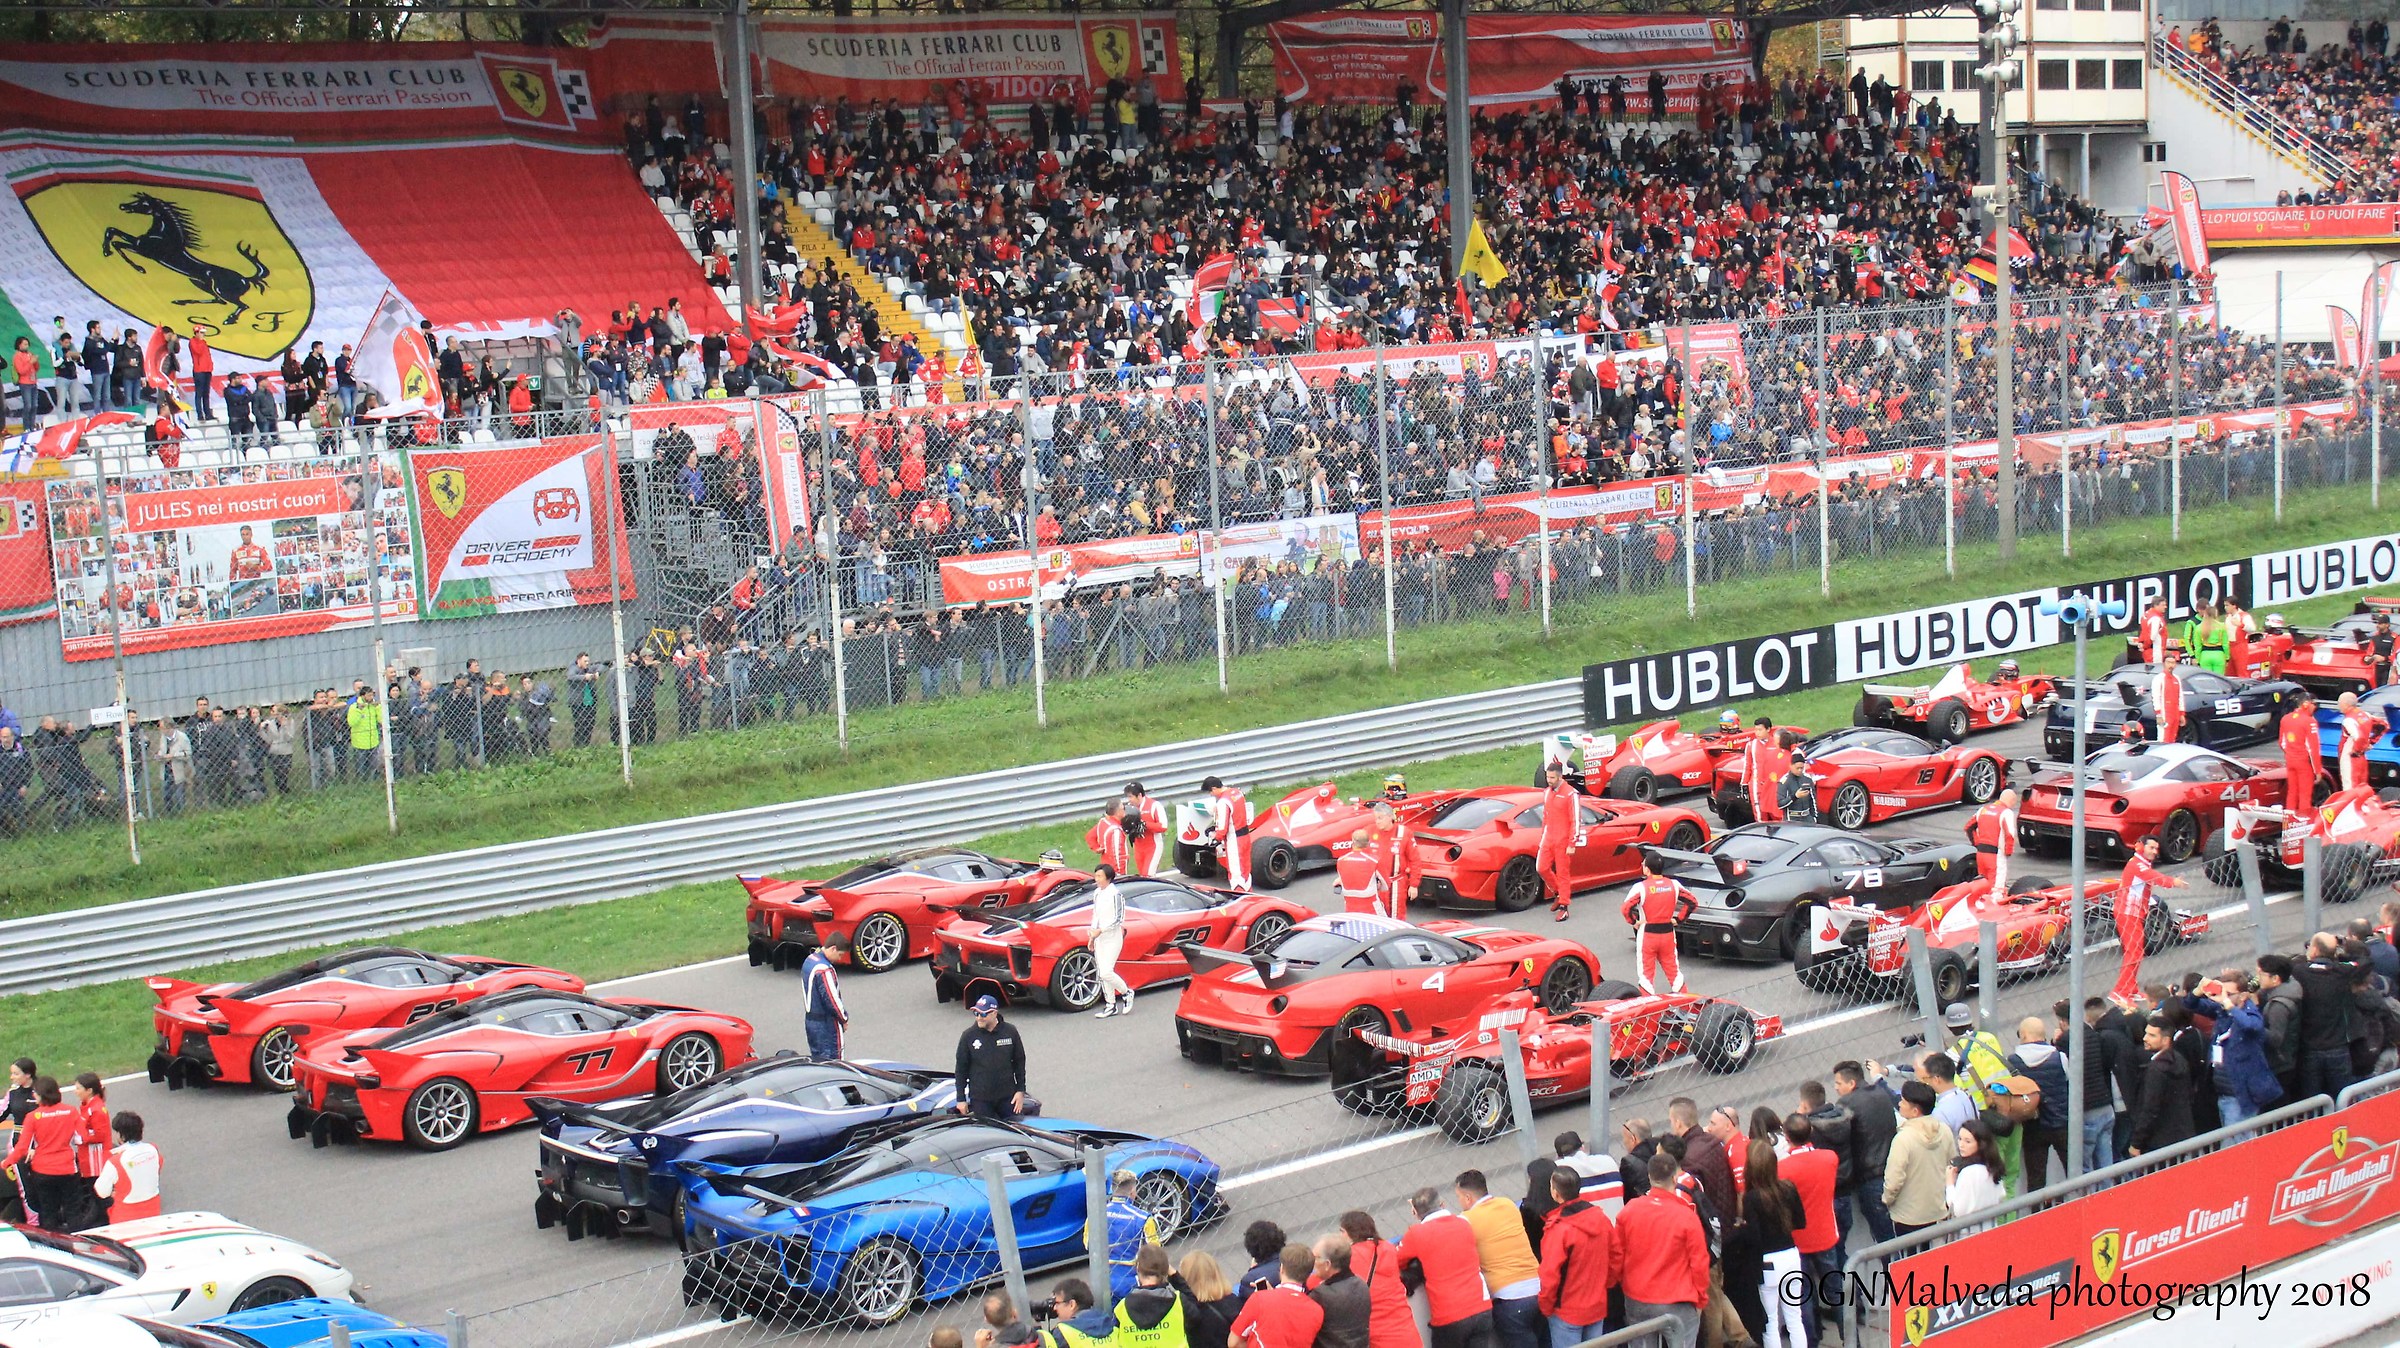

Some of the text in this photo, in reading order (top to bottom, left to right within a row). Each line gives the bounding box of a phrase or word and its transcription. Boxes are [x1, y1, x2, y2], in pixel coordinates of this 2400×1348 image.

[807, 33, 1062, 57] SCUDERIA FERRARI CLUB
[1587, 27, 1705, 42] SCUDERIA FERRARI CLUB
[883, 55, 1066, 76] The Official Ferrari Passion
[64, 68, 466, 88] SCUDERIA FERRARI CLUB
[193, 88, 472, 107] The Official Ferrari Passion
[2208, 213, 2224, 225] LO
[2225, 212, 2251, 224] PUOI
[2253, 210, 2307, 223] SOGNARE,
[2310, 209, 2324, 220] LO
[2328, 209, 2354, 220] PUOI
[1506, 343, 1577, 374] GRZIE
[136, 488, 327, 526] JULES nei nostri cuori
[1546, 491, 1650, 510] SCUDERIA FERRARI CLUB
[465, 540, 577, 564] DRIVER ACADEMY
[2267, 538, 2400, 601] HUBLO
[1855, 596, 2042, 668] HUBLOT
[1603, 630, 1819, 720] HUBLOT
[2215, 698, 2242, 715] 96
[1681, 771, 1702, 780] acer
[1915, 767, 1936, 786] 18
[2220, 784, 2250, 802] 44
[1842, 868, 1883, 890] 78
[978, 892, 1010, 909] 21
[1173, 924, 1213, 945] 20
[1876, 922, 1901, 932] V-Power
[1421, 971, 1445, 993] 4
[566, 1046, 616, 1075] 77
[1410, 1071, 1433, 1083] AMD
[1529, 1084, 1562, 1097] acer
[2281, 1154, 2390, 1211] Finali Mondiali
[2122, 1196, 2249, 1261] Corse Clienti
[1933, 1302, 1966, 1328] XX
[1134, 1332, 1161, 1342] FOTO
